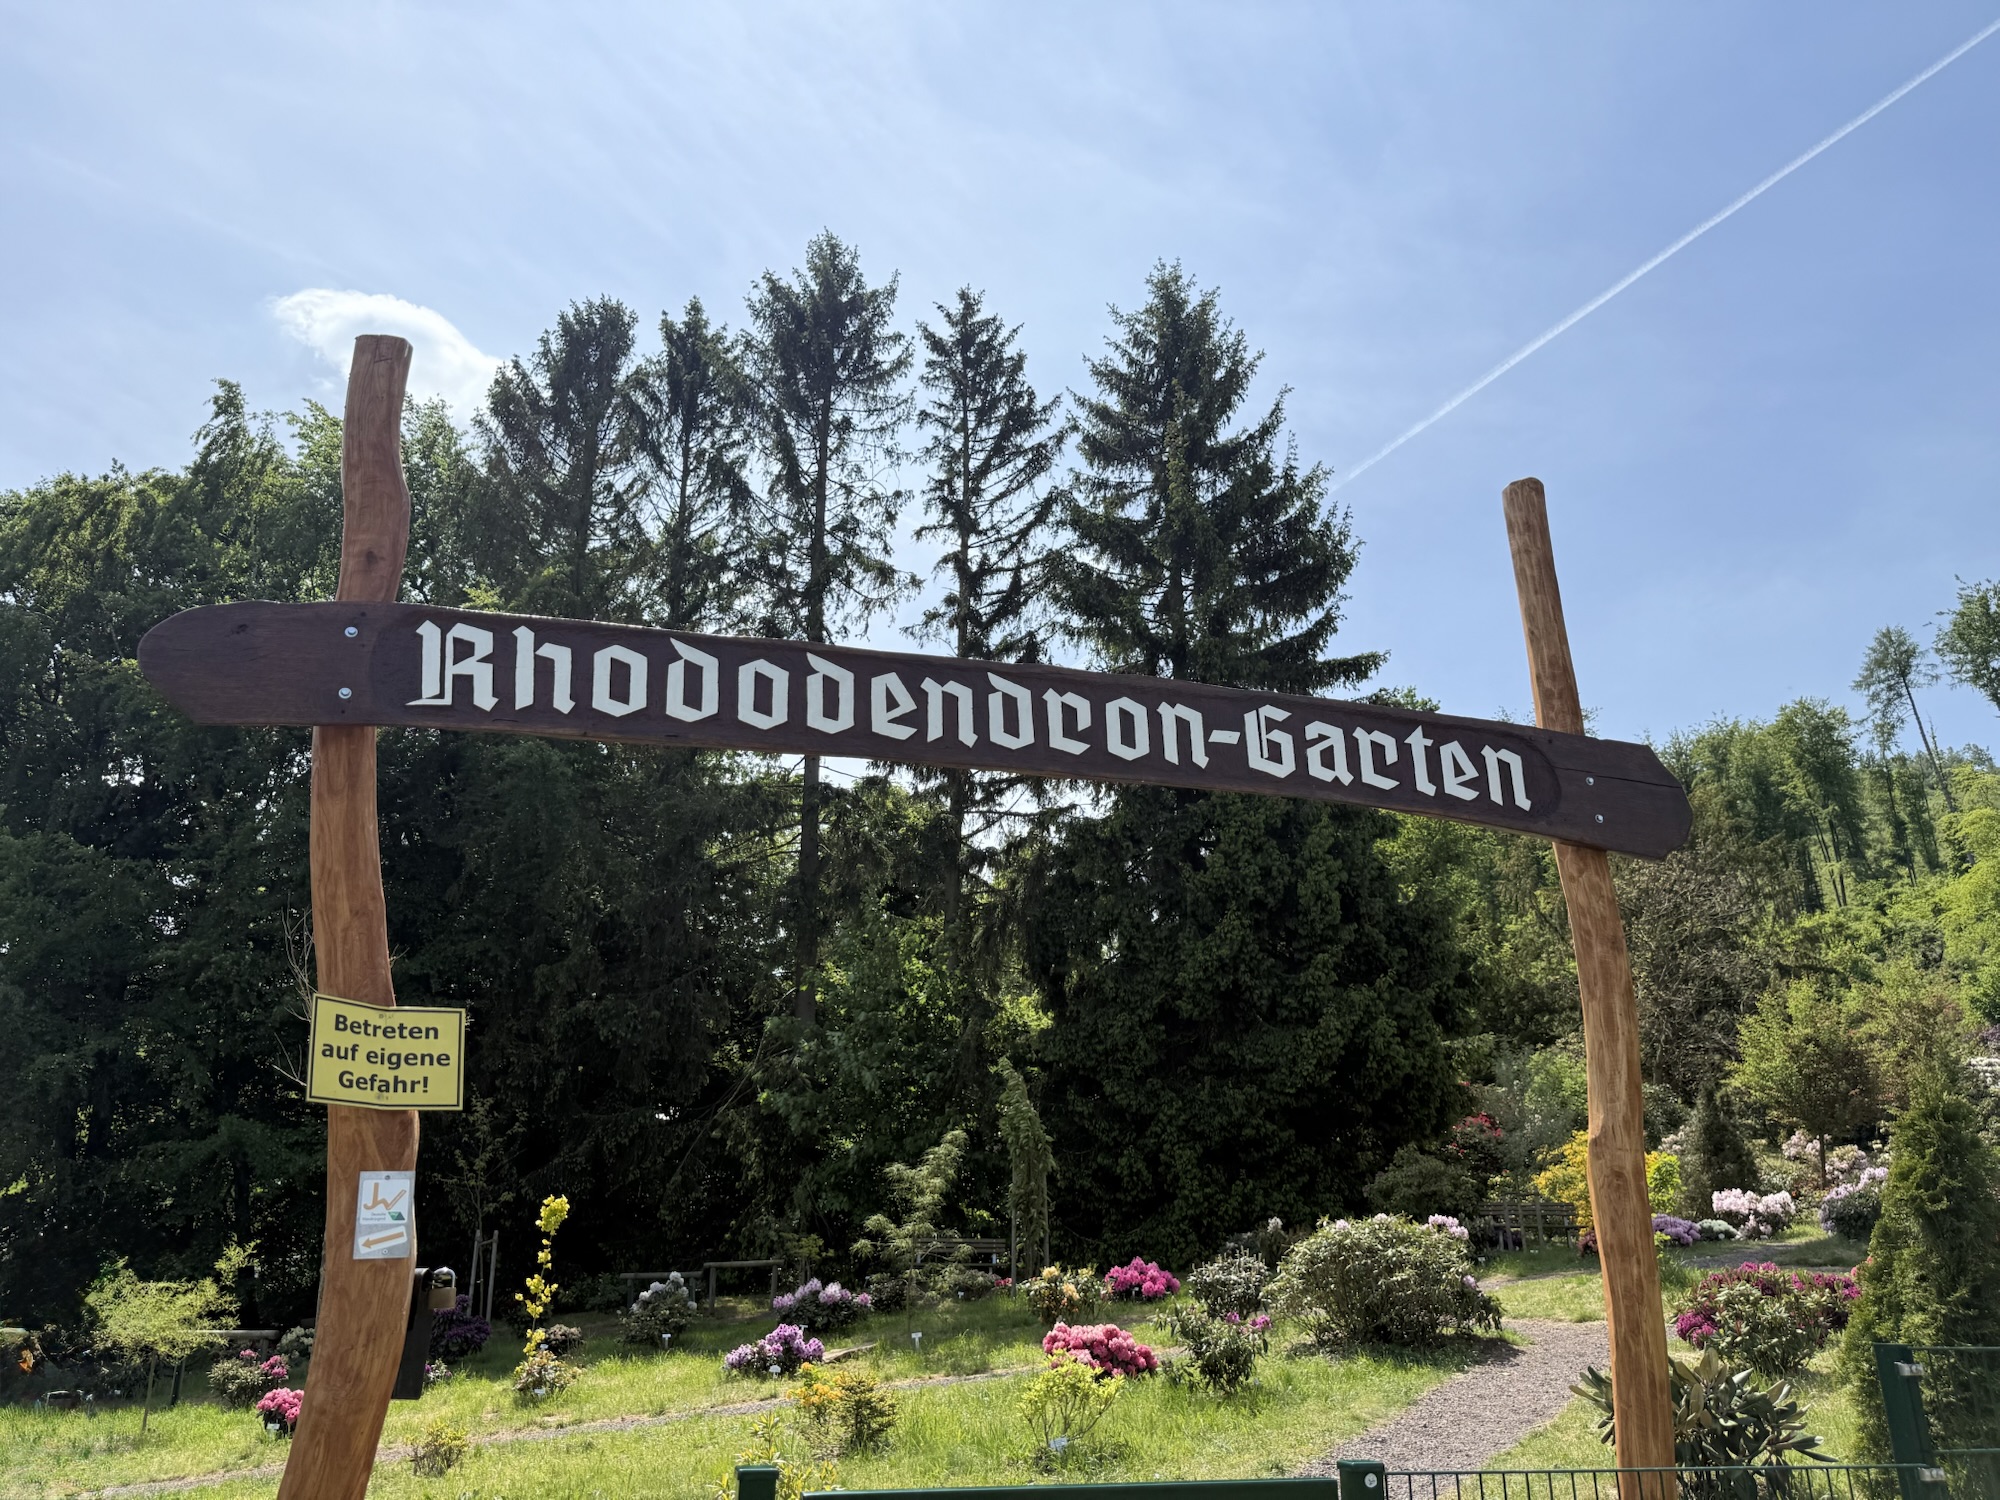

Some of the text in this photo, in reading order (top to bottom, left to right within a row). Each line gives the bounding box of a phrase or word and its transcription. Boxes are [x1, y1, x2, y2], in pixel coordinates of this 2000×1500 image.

[405, 620, 1533, 811] Rhododendron-Garten
[334, 1013, 439, 1040] Betreten
[321, 1043, 451, 1071] auf eigene
[338, 1070, 429, 1094] Gefahr!
